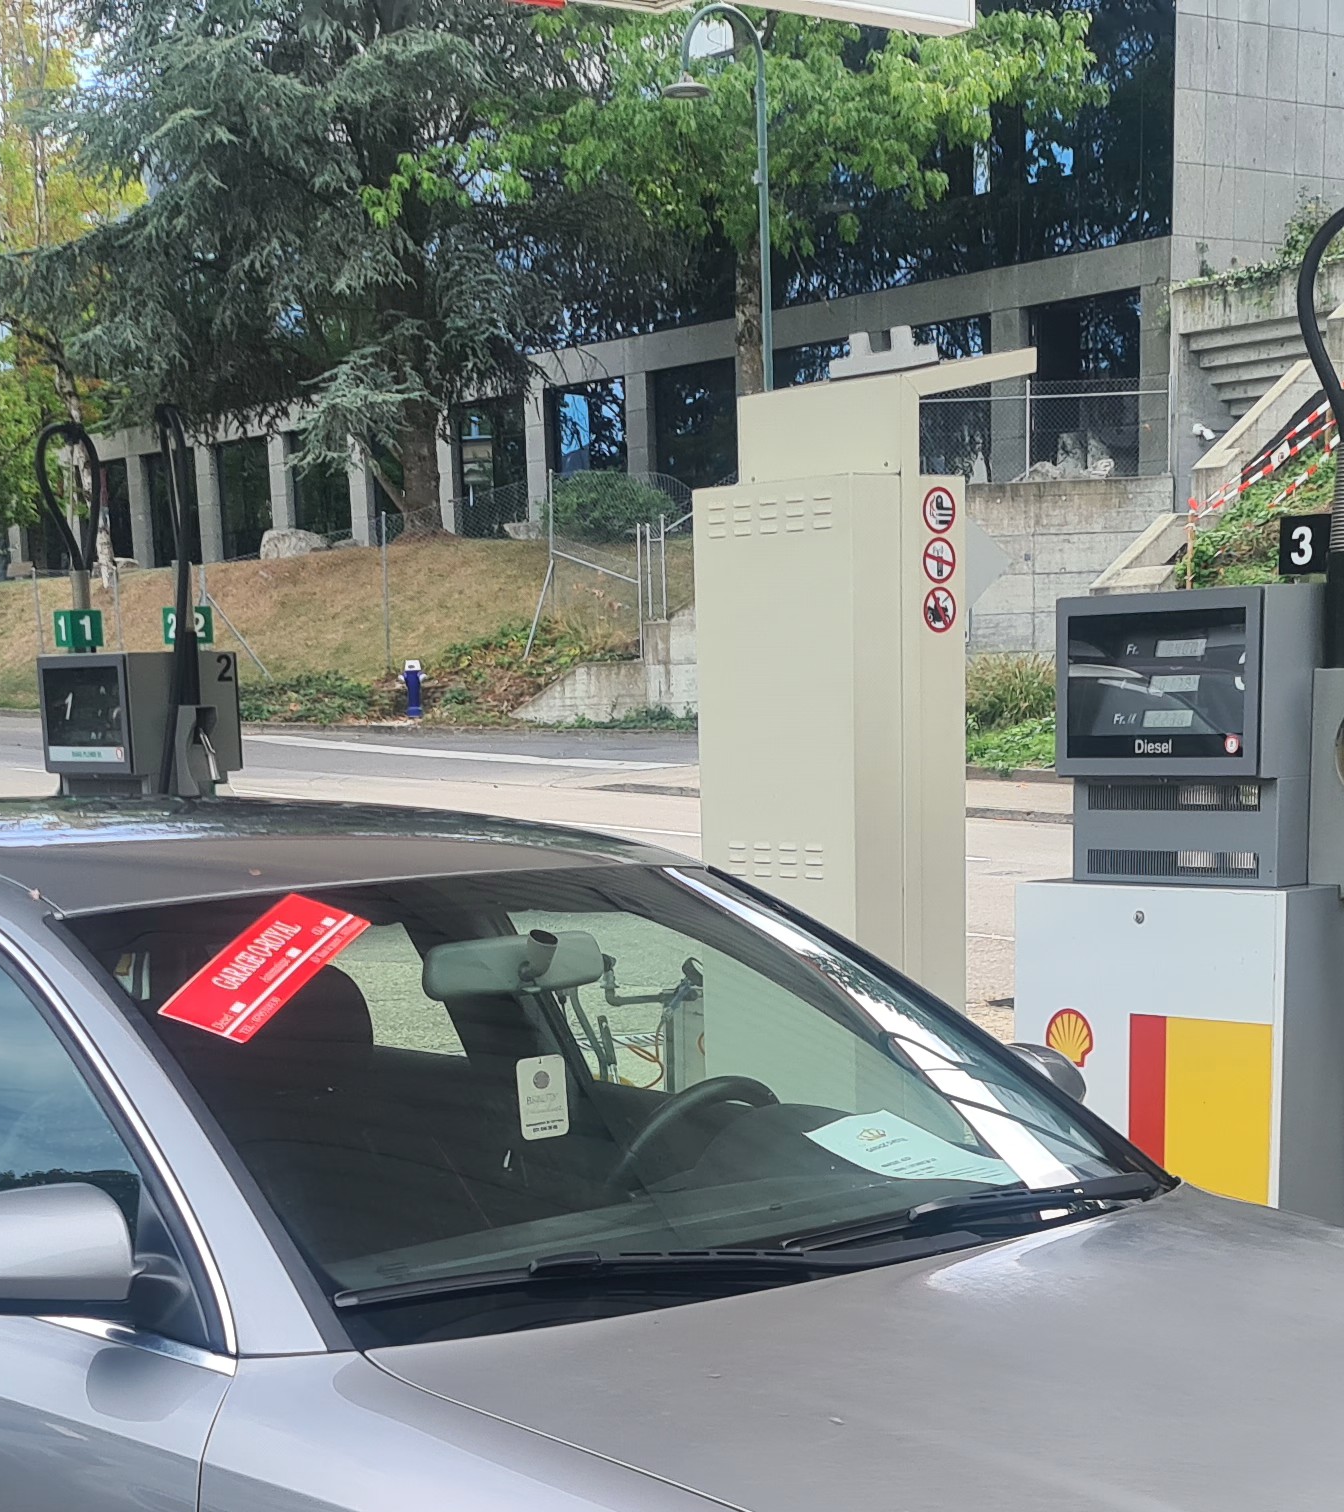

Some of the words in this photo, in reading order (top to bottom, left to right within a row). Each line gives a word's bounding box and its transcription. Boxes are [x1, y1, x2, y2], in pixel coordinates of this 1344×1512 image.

[1290, 525, 1313, 566] 3
[58, 615, 67, 642] 1
[79, 615, 93, 641] 1
[216, 654, 233, 682] 2
[1134, 738, 1173, 754] Diesel
[211, 946, 264, 991] GARAGE
